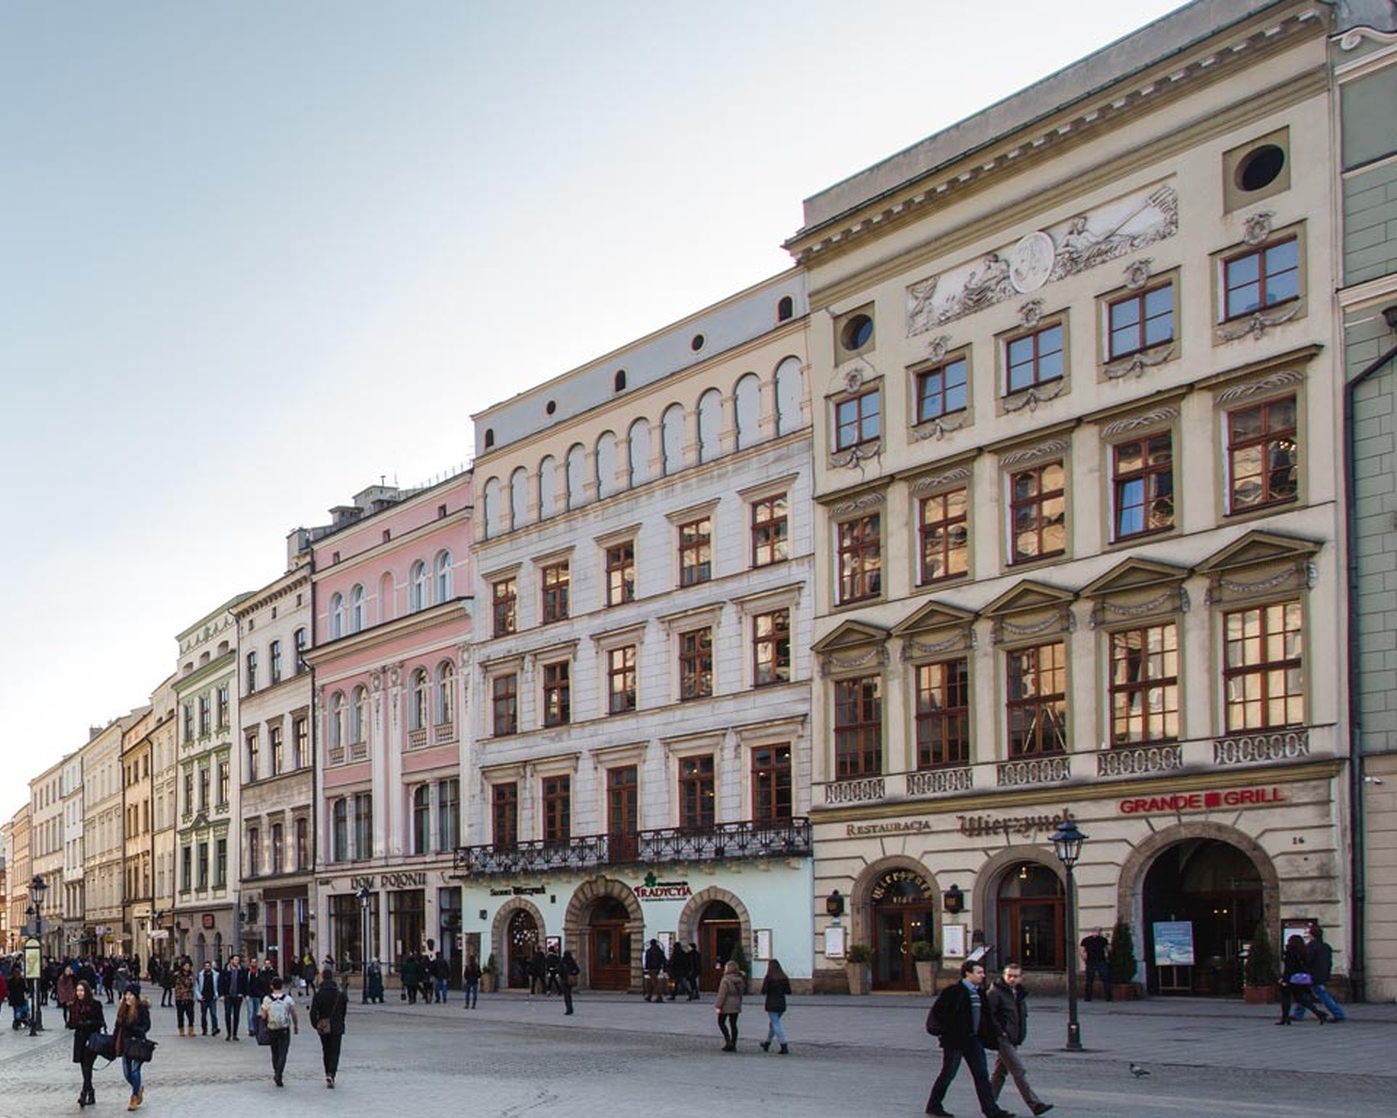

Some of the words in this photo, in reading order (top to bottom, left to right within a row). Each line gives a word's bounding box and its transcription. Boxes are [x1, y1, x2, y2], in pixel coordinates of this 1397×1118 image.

[1119, 793, 1203, 815] GRANDE
[1223, 786, 1286, 806] GRILL
[1292, 836, 1305, 845] 16
